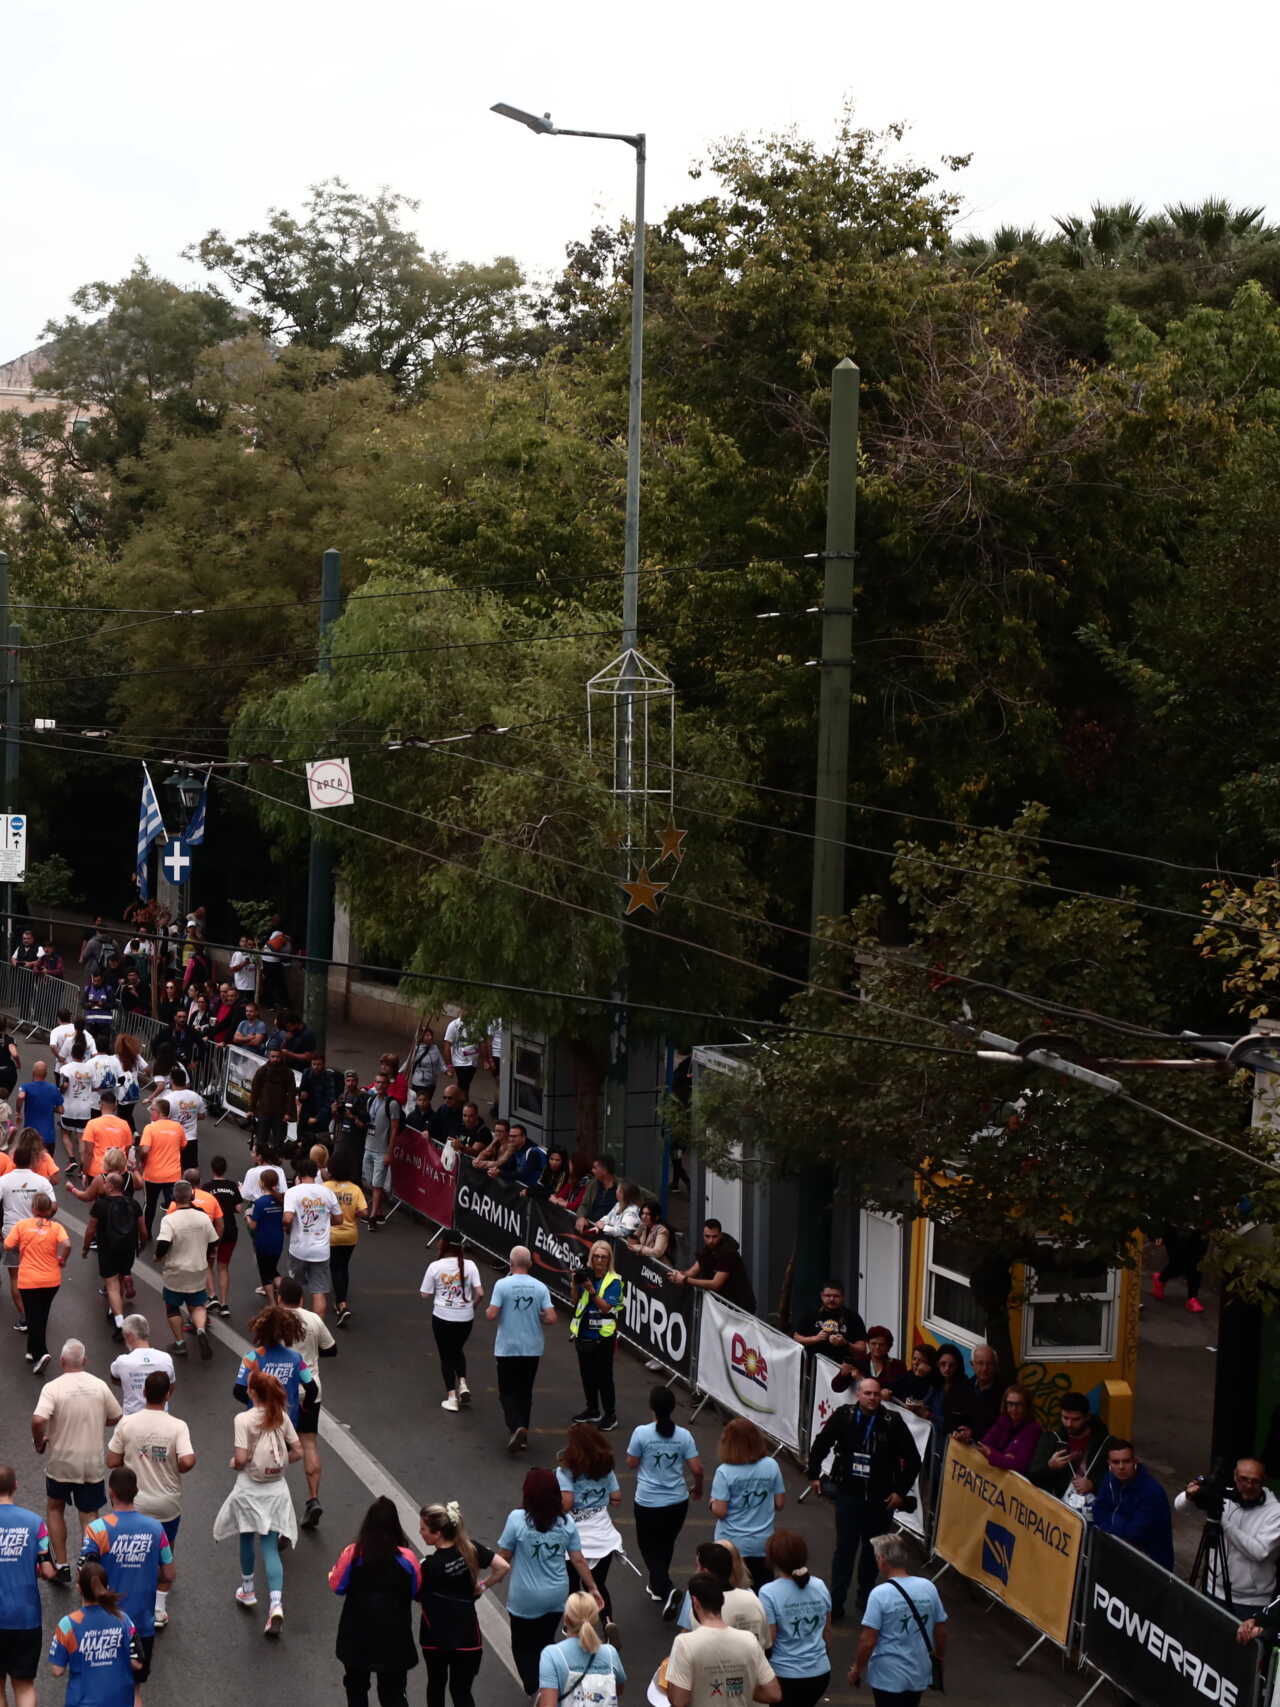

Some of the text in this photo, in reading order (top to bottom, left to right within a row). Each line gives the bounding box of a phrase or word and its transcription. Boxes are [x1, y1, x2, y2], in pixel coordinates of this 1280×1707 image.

[316, 777, 343, 791] ΑΡΓΑ
[393, 1146, 454, 1186] GRAND HYATT
[458, 1185, 520, 1237] GARMIN
[640, 1265, 663, 1287] DANONE
[731, 1332, 768, 1382] Dole
[951, 1459, 1072, 1557] ΤΡΑΠΕΖΑ ΠΕΙΡΑΙΩΣ
[1093, 1582, 1238, 1707] POWERADE
